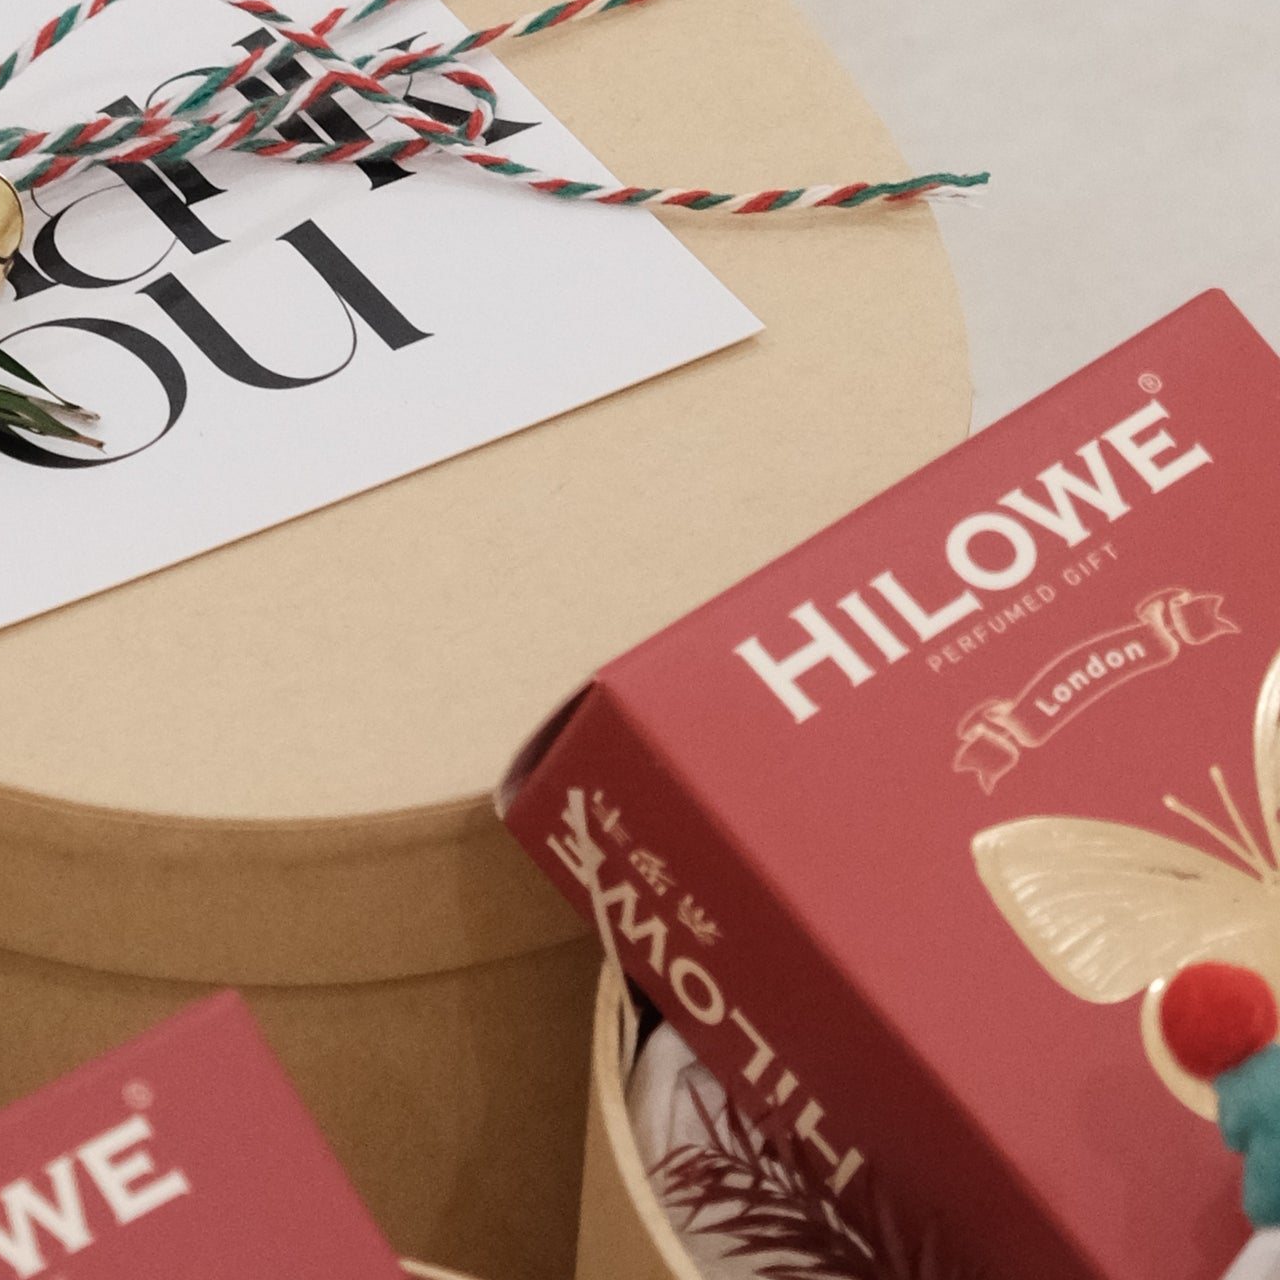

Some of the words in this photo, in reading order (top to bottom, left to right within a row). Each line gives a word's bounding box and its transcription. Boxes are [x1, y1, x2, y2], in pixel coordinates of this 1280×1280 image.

[731, 397, 1214, 725] HILOWE
[926, 583, 1057, 673] PERFUMED
[1061, 541, 1119, 587] GIFT
[1034, 641, 1146, 717] London
